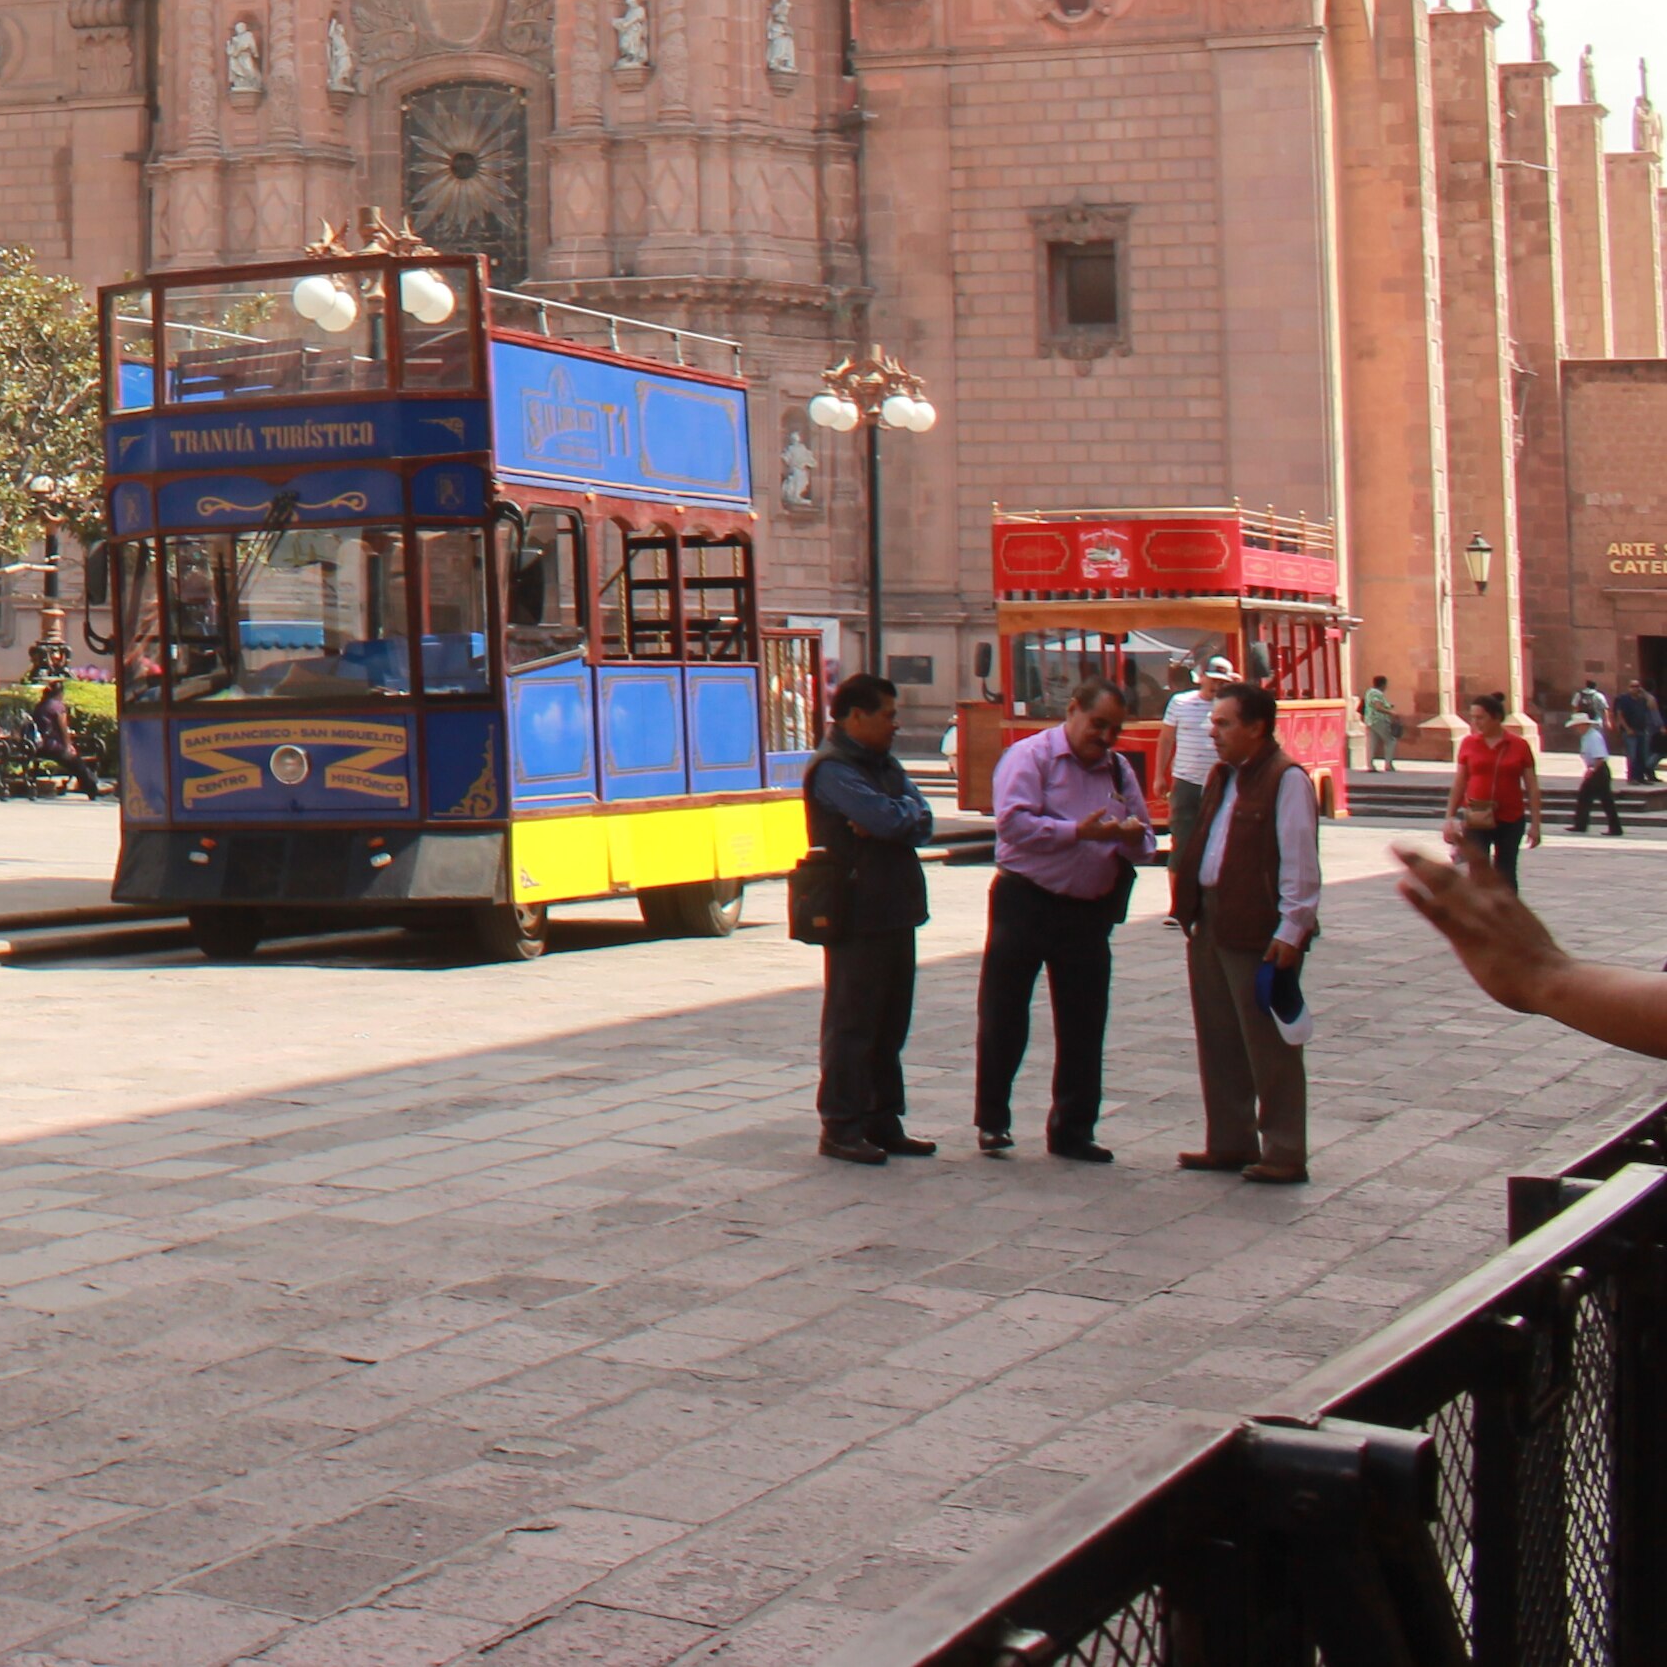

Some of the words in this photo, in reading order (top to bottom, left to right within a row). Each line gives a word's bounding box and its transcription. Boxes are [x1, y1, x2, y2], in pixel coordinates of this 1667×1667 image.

[170, 422, 255, 454] TRANVÍA
[261, 419, 374, 450] TURÍSTICO
[1606, 542, 1657, 556] ARTE
[185, 736, 212, 748] SAN
[196, 774, 249, 794] CENTRO
